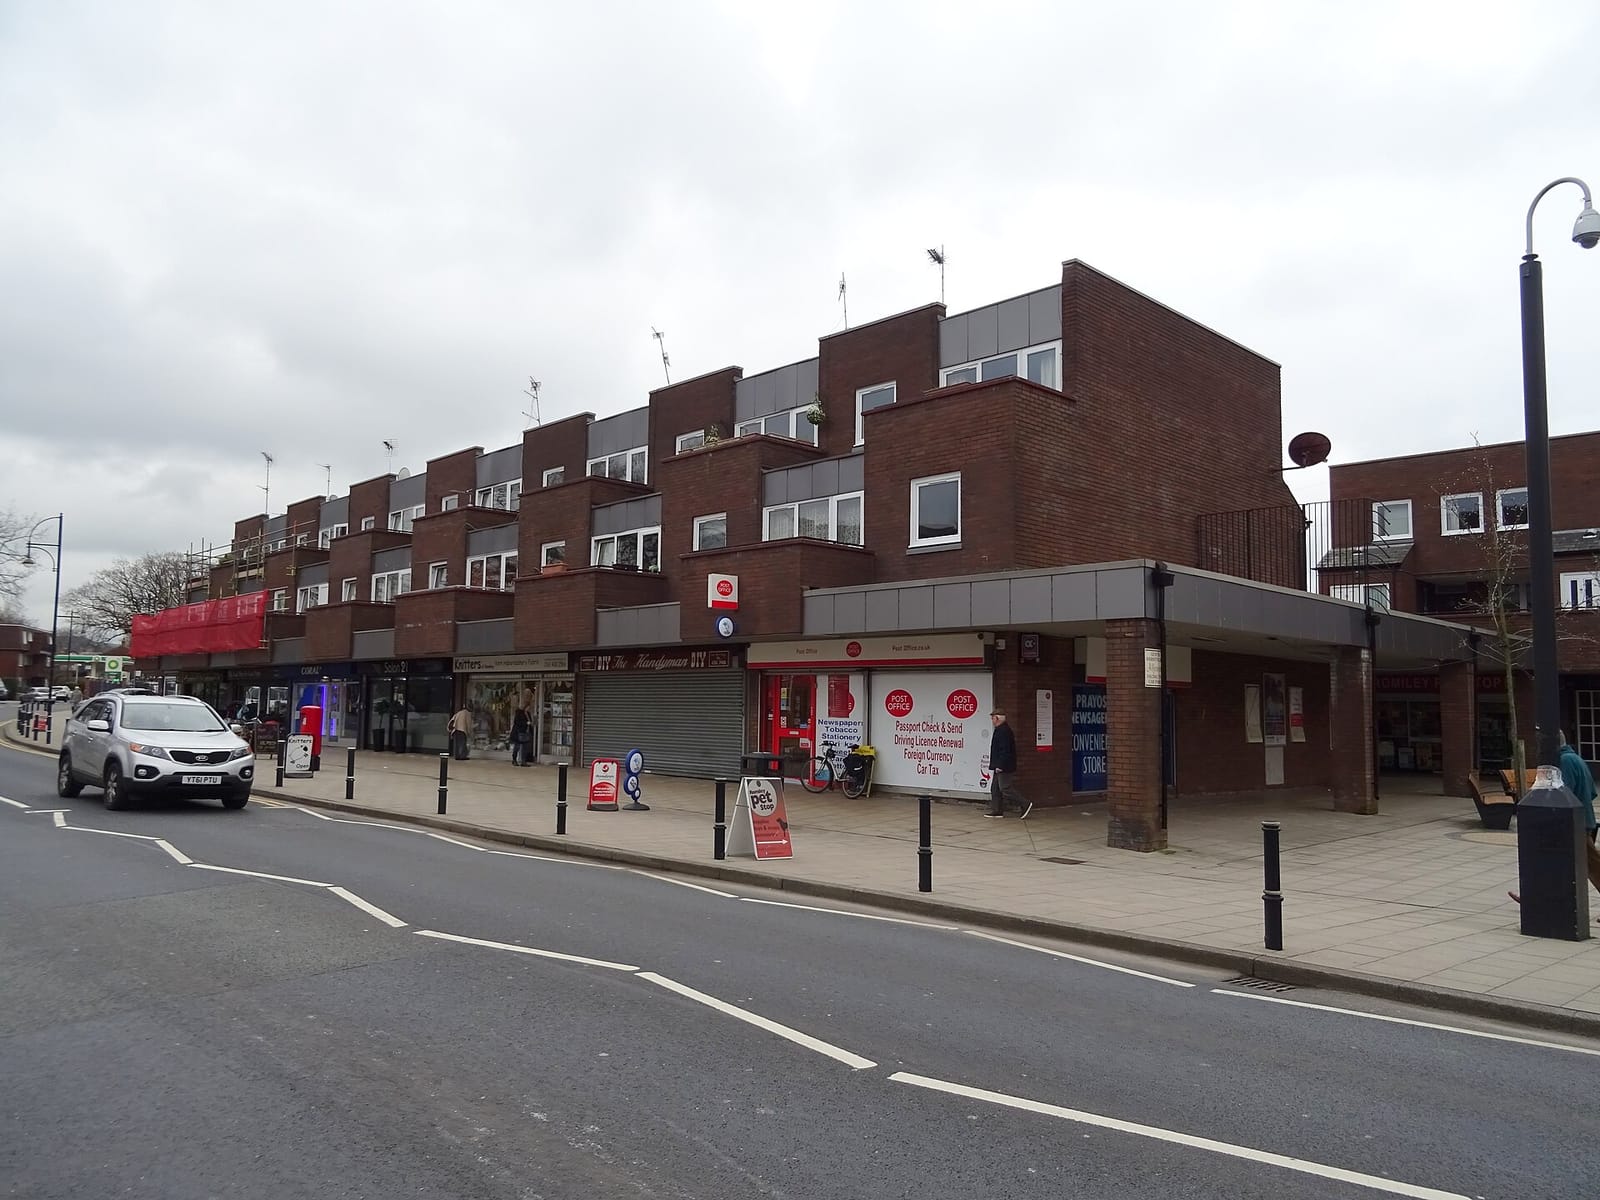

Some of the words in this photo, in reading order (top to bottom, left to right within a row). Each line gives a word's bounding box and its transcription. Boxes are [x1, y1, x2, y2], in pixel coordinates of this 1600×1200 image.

[454, 658, 481, 670] Knitters
[597, 655, 611, 671] DIY
[634, 653, 689, 670] Handyman
[691, 651, 706, 668] DIY
[953, 695, 971, 703] POST
[1076, 694, 1107, 708] PRAYOS
[887, 702, 910, 711] OFFICE
[949, 703, 974, 712] OFFICE
[1072, 711, 1106, 724] EWSAGE
[895, 720, 921, 734] Passport
[921, 721, 940, 734] Check
[941, 723, 946, 733] &
[946, 722, 963, 734] Send
[821, 733, 861, 742] Stationery
[894, 734, 914, 748] Driving
[915, 735, 938, 748] Licence
[938, 736, 964, 749] Renewal
[1072, 734, 1110, 751] ONVENIE
[903, 748, 926, 762] Foreign
[926, 749, 954, 765] Currency
[916, 763, 927, 775] Car
[928, 763, 939, 776] Tax
[1083, 755, 1107, 774] STORE
[750, 789, 773, 810] pet
[760, 803, 775, 812] stop
